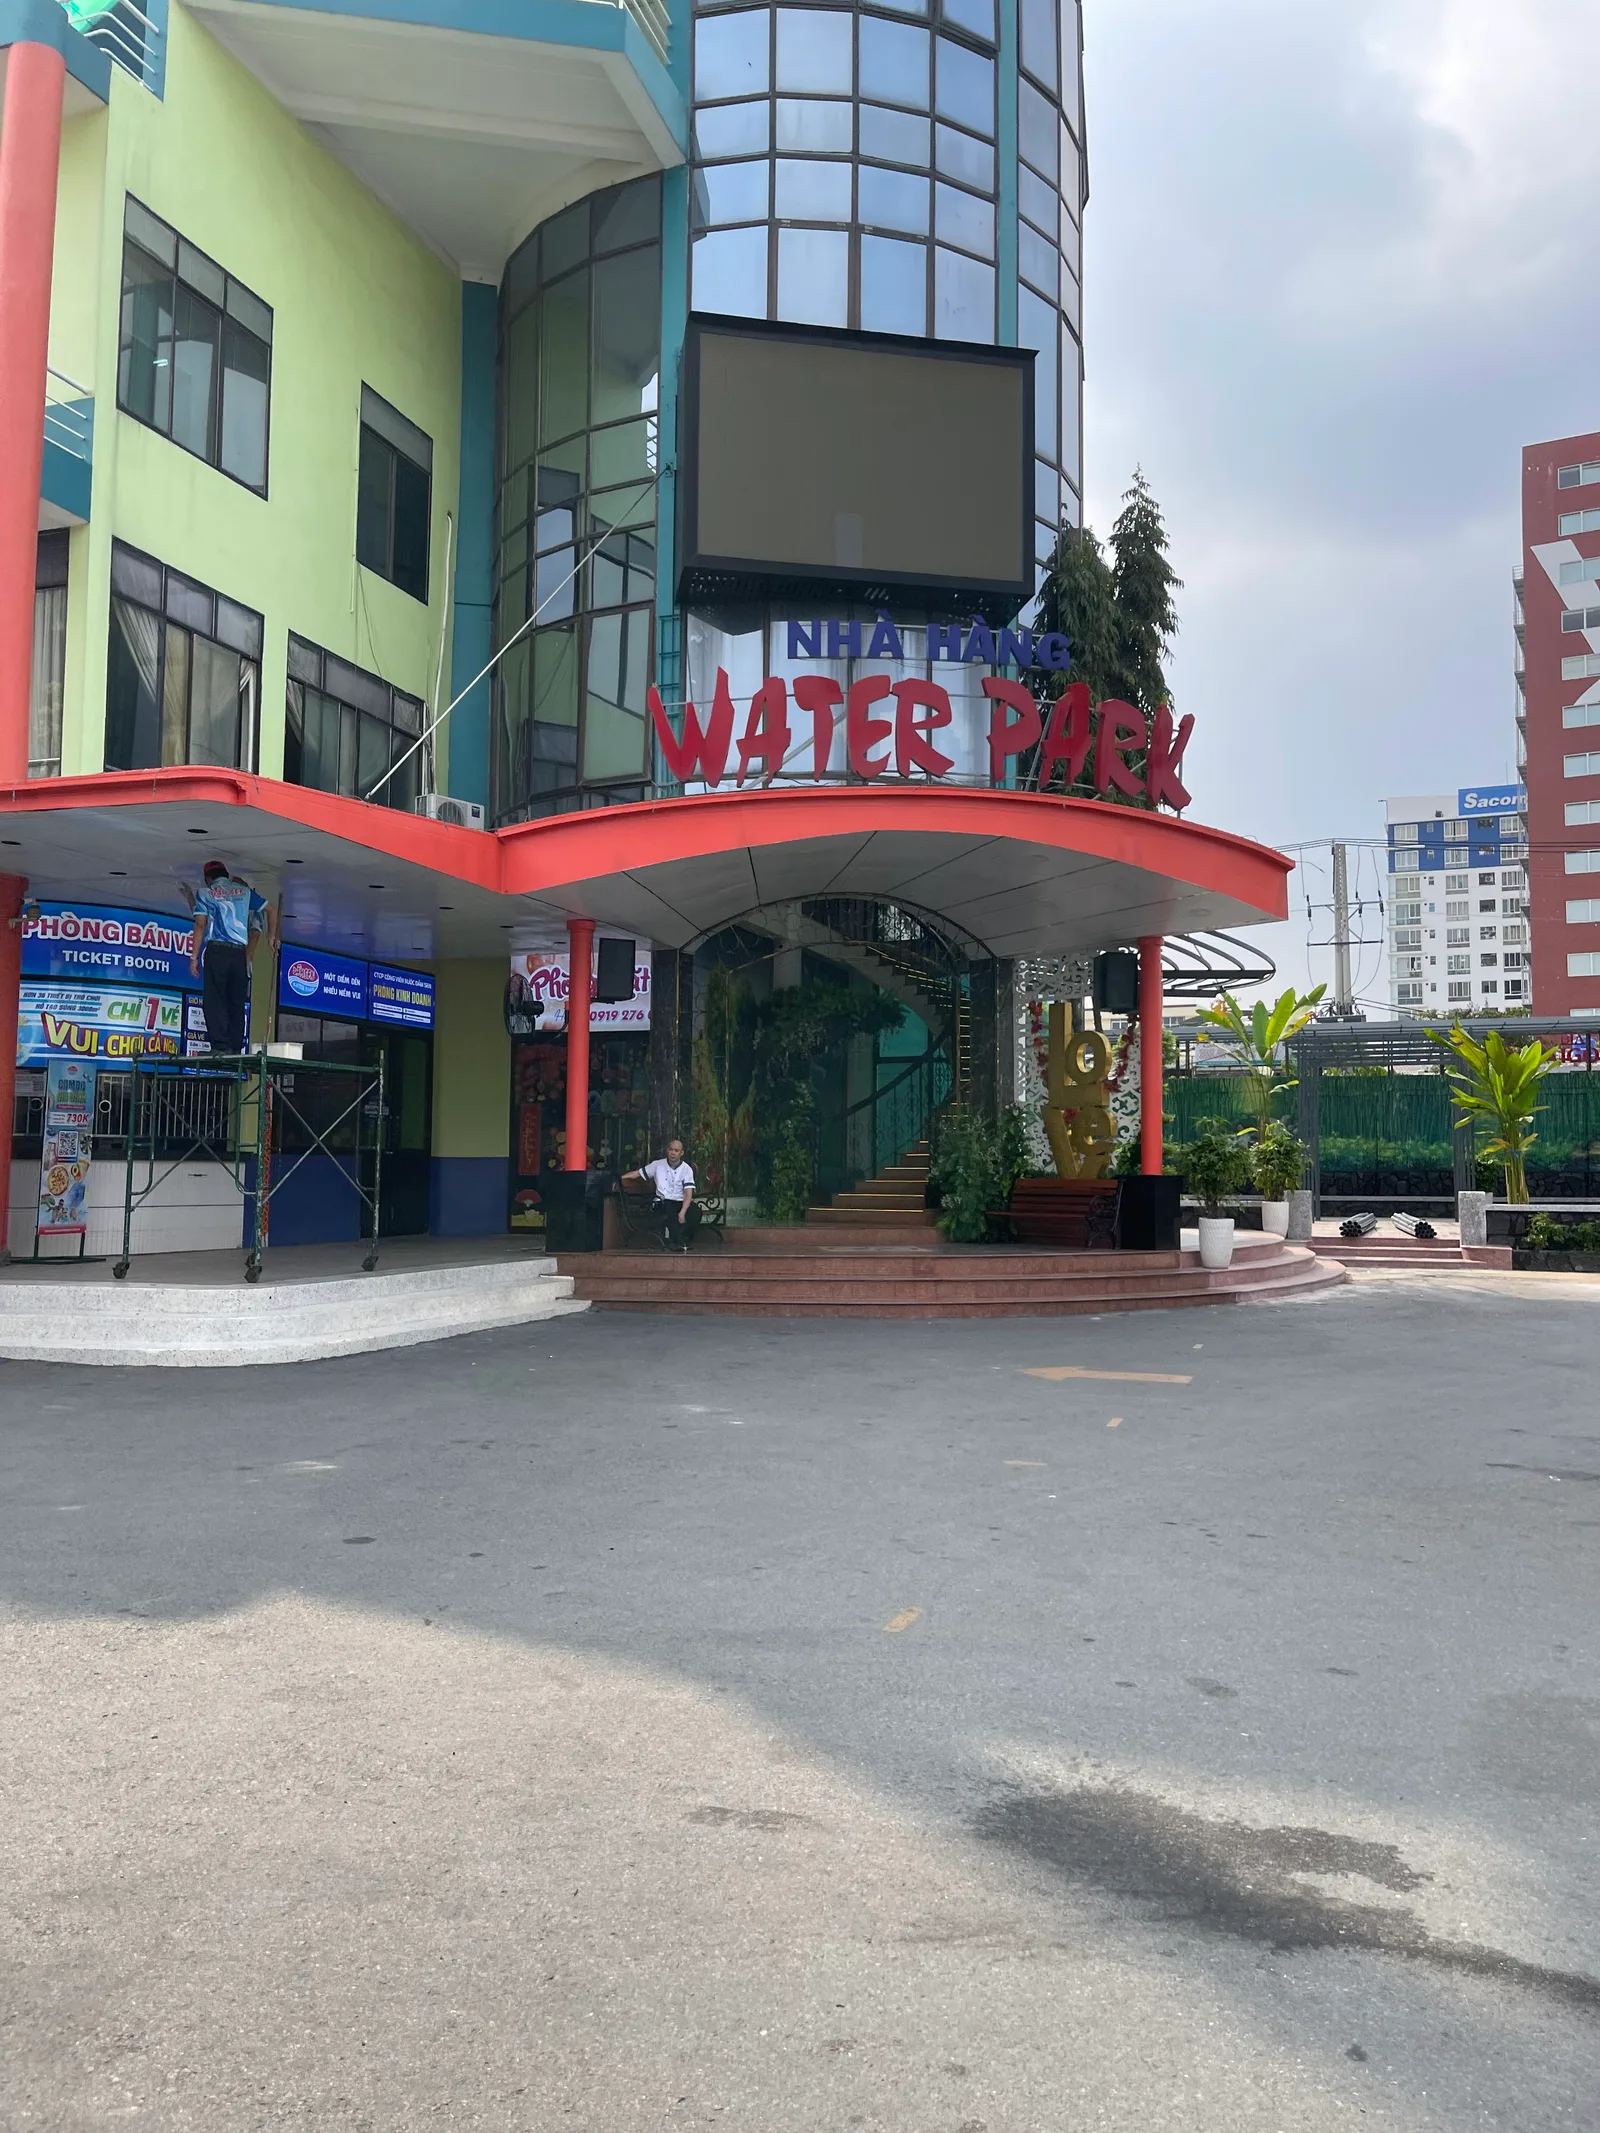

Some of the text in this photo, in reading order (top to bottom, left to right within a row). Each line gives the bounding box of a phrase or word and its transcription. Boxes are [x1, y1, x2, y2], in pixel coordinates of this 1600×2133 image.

[787, 609, 1070, 671] NHÀ HÀNG
[647, 666, 1196, 811] WATER PARK
[22, 912, 121, 943] PHÒNG
[125, 922, 171, 951] BÁN
[62, 950, 170, 973] TICKET BOOTH
[107, 996, 180, 1031] CHỈ 1 VÉ
[621, 1009, 644, 1021] 276
[41, 1011, 99, 1057] VUI
[106, 1033, 145, 1057] CHƠI
[147, 1030, 162, 1055] CẢ
[66, 1113, 89, 1123] 730K
